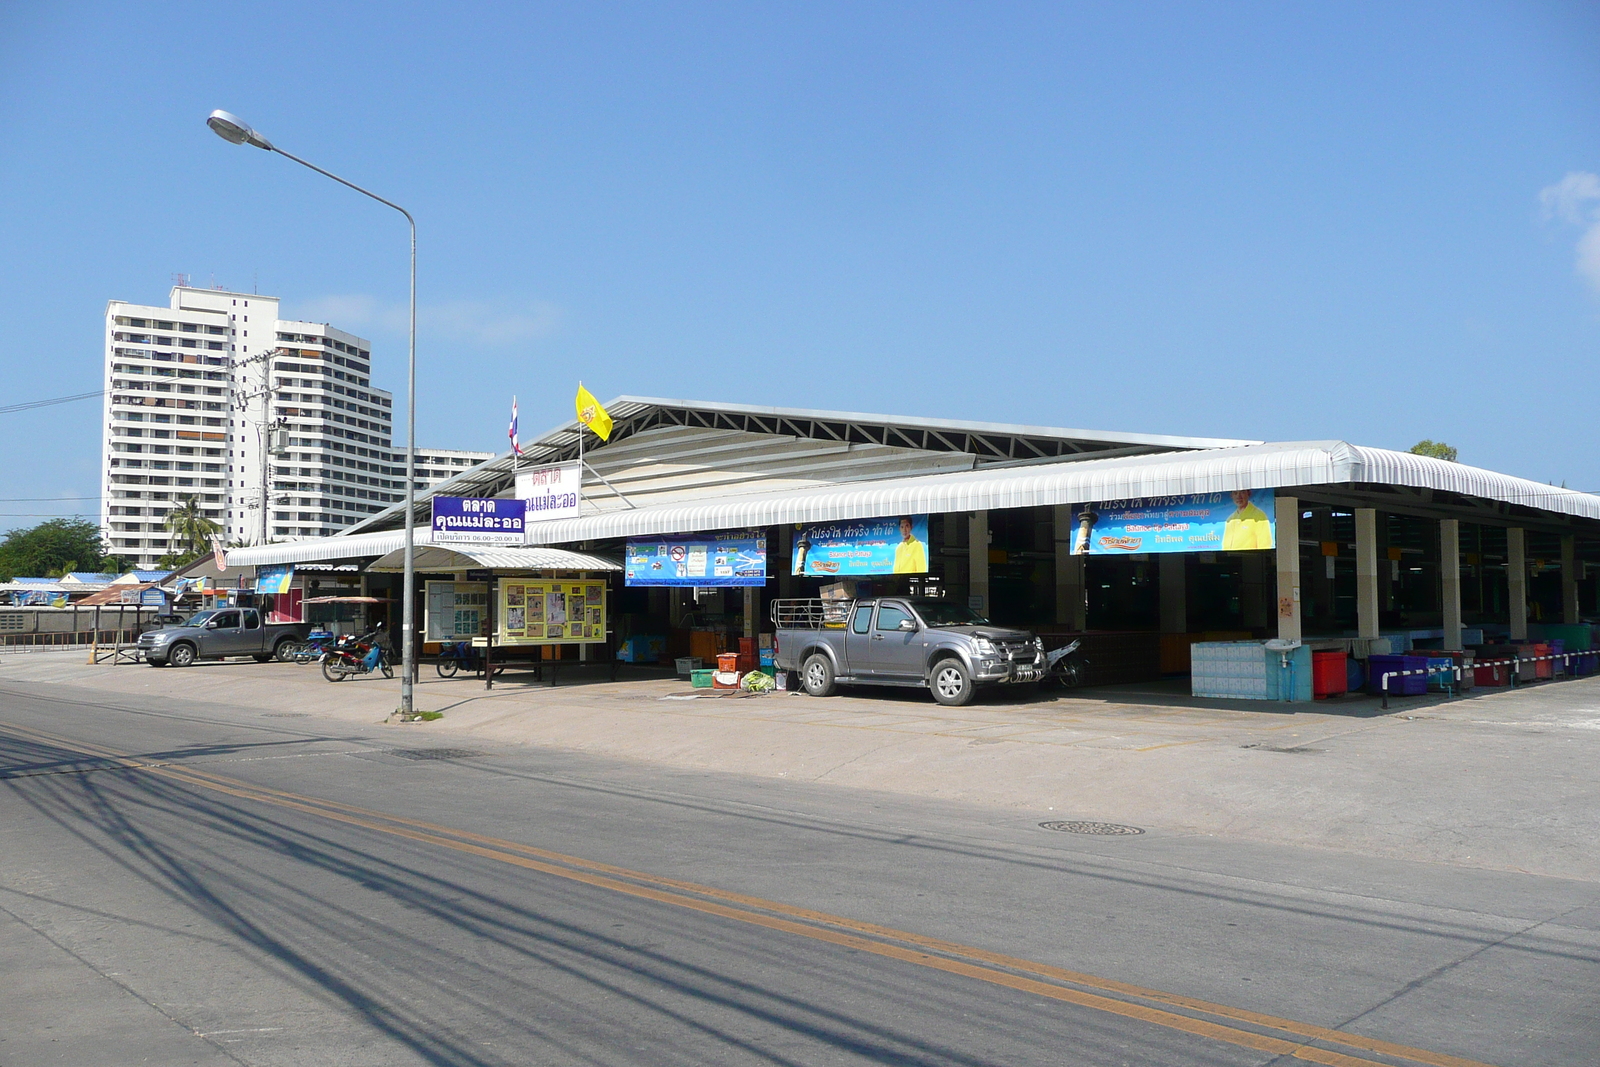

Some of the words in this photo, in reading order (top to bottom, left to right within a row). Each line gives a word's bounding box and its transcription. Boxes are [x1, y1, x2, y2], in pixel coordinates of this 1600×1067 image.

[532, 467, 561, 486] ตลาด
[462, 499, 495, 513] ตลาด
[436, 512, 522, 532] คุณแม่ละออ
[1126, 523, 1152, 532] Balance
[1154, 524, 1162, 533] Up
[1163, 522, 1189, 532] Pattaya
[437, 532, 471, 541] เปิดบริการ
